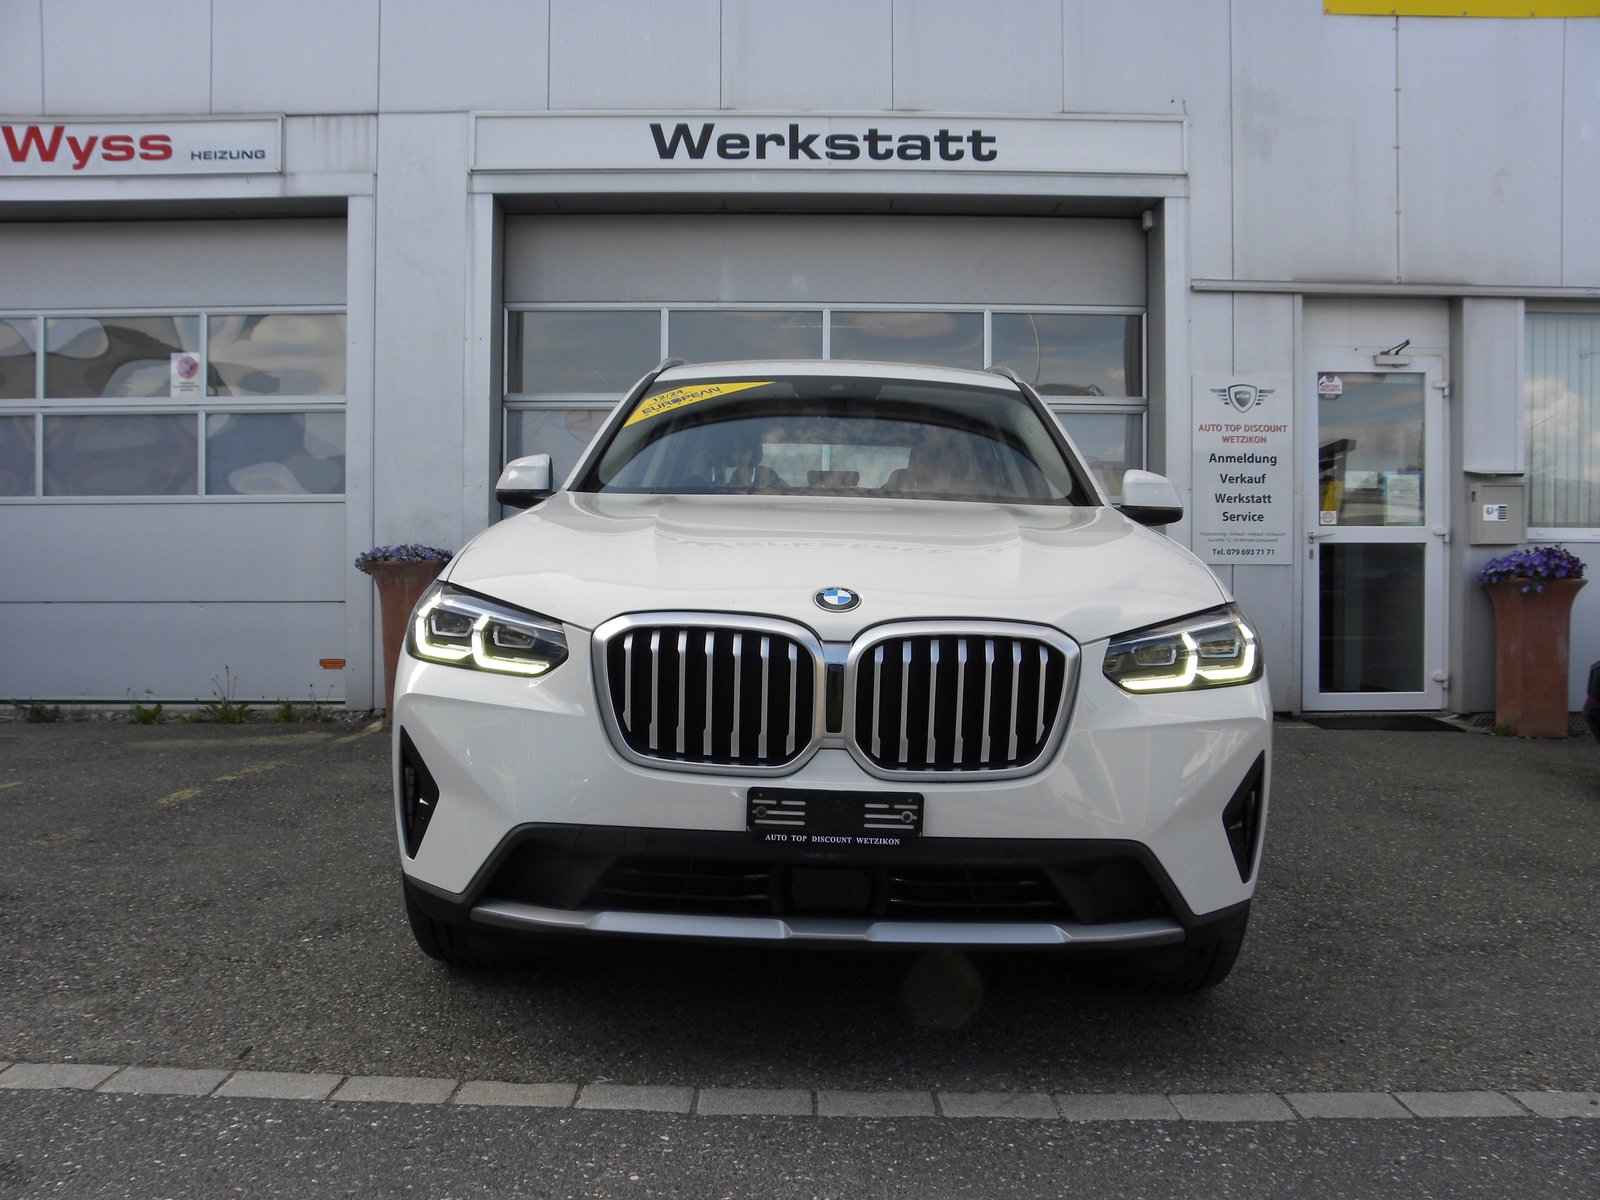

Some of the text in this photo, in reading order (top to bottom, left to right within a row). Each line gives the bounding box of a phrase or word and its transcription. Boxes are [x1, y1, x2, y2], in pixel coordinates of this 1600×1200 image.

[1, 125, 266, 170] Wyss HEIZUNG
[649, 123, 998, 162] Werkstatt
[653, 389, 684, 402] 12/24
[1198, 424, 1288, 433] AUTO TOP DISCOUNT
[1221, 435, 1267, 444] WETZIKON
[1208, 453, 1277, 466] Anmeldung
[1220, 473, 1266, 484] Verkauf
[1214, 493, 1272, 504] Werkstatt
[1222, 511, 1264, 522] Service
[791, 834, 807, 842] TOP
[812, 835, 852, 844] DISCOUNT
[856, 837, 900, 845] WETZIKON
